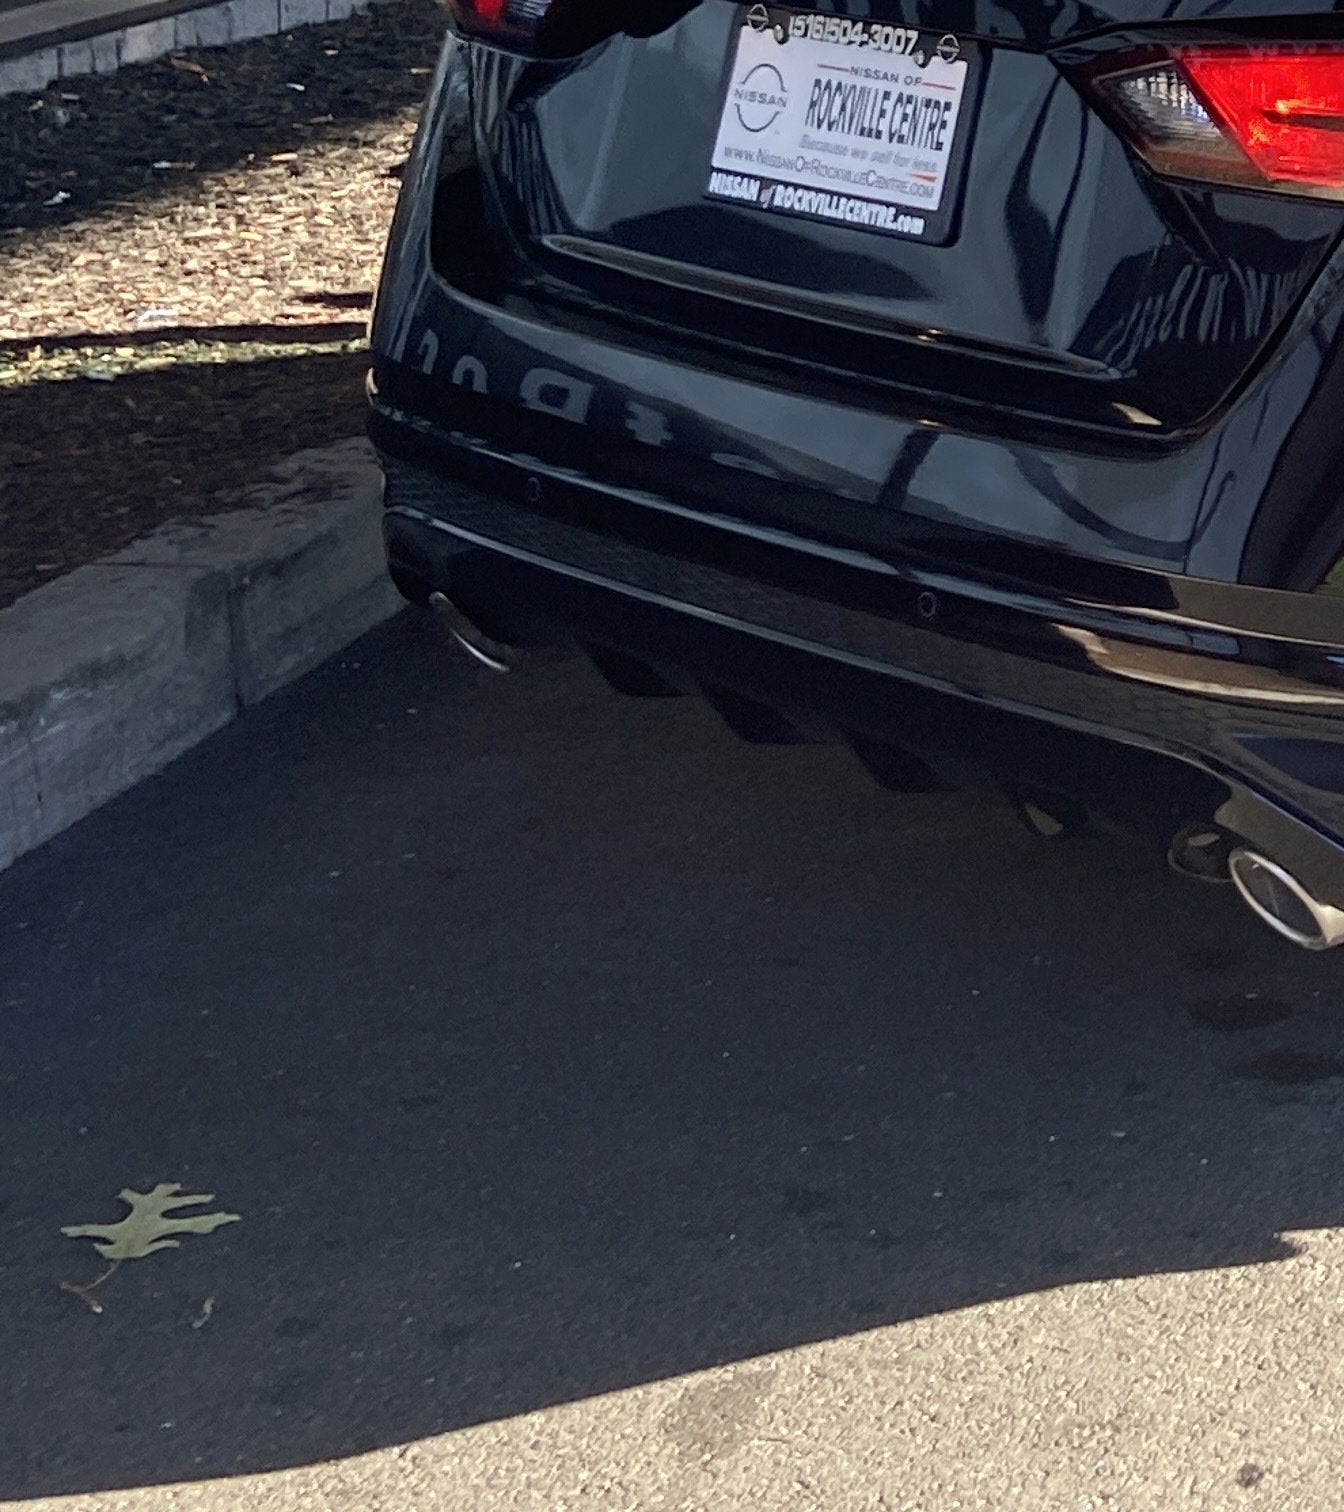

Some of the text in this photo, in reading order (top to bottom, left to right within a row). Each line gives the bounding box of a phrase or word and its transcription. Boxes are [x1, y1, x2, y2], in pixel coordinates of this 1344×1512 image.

[850, 65, 922, 87] NISSAN OF
[734, 87, 787, 108] NISSAN
[804, 78, 953, 152] ROCKVILLE CENTRE
[709, 171, 761, 201] NISSAN
